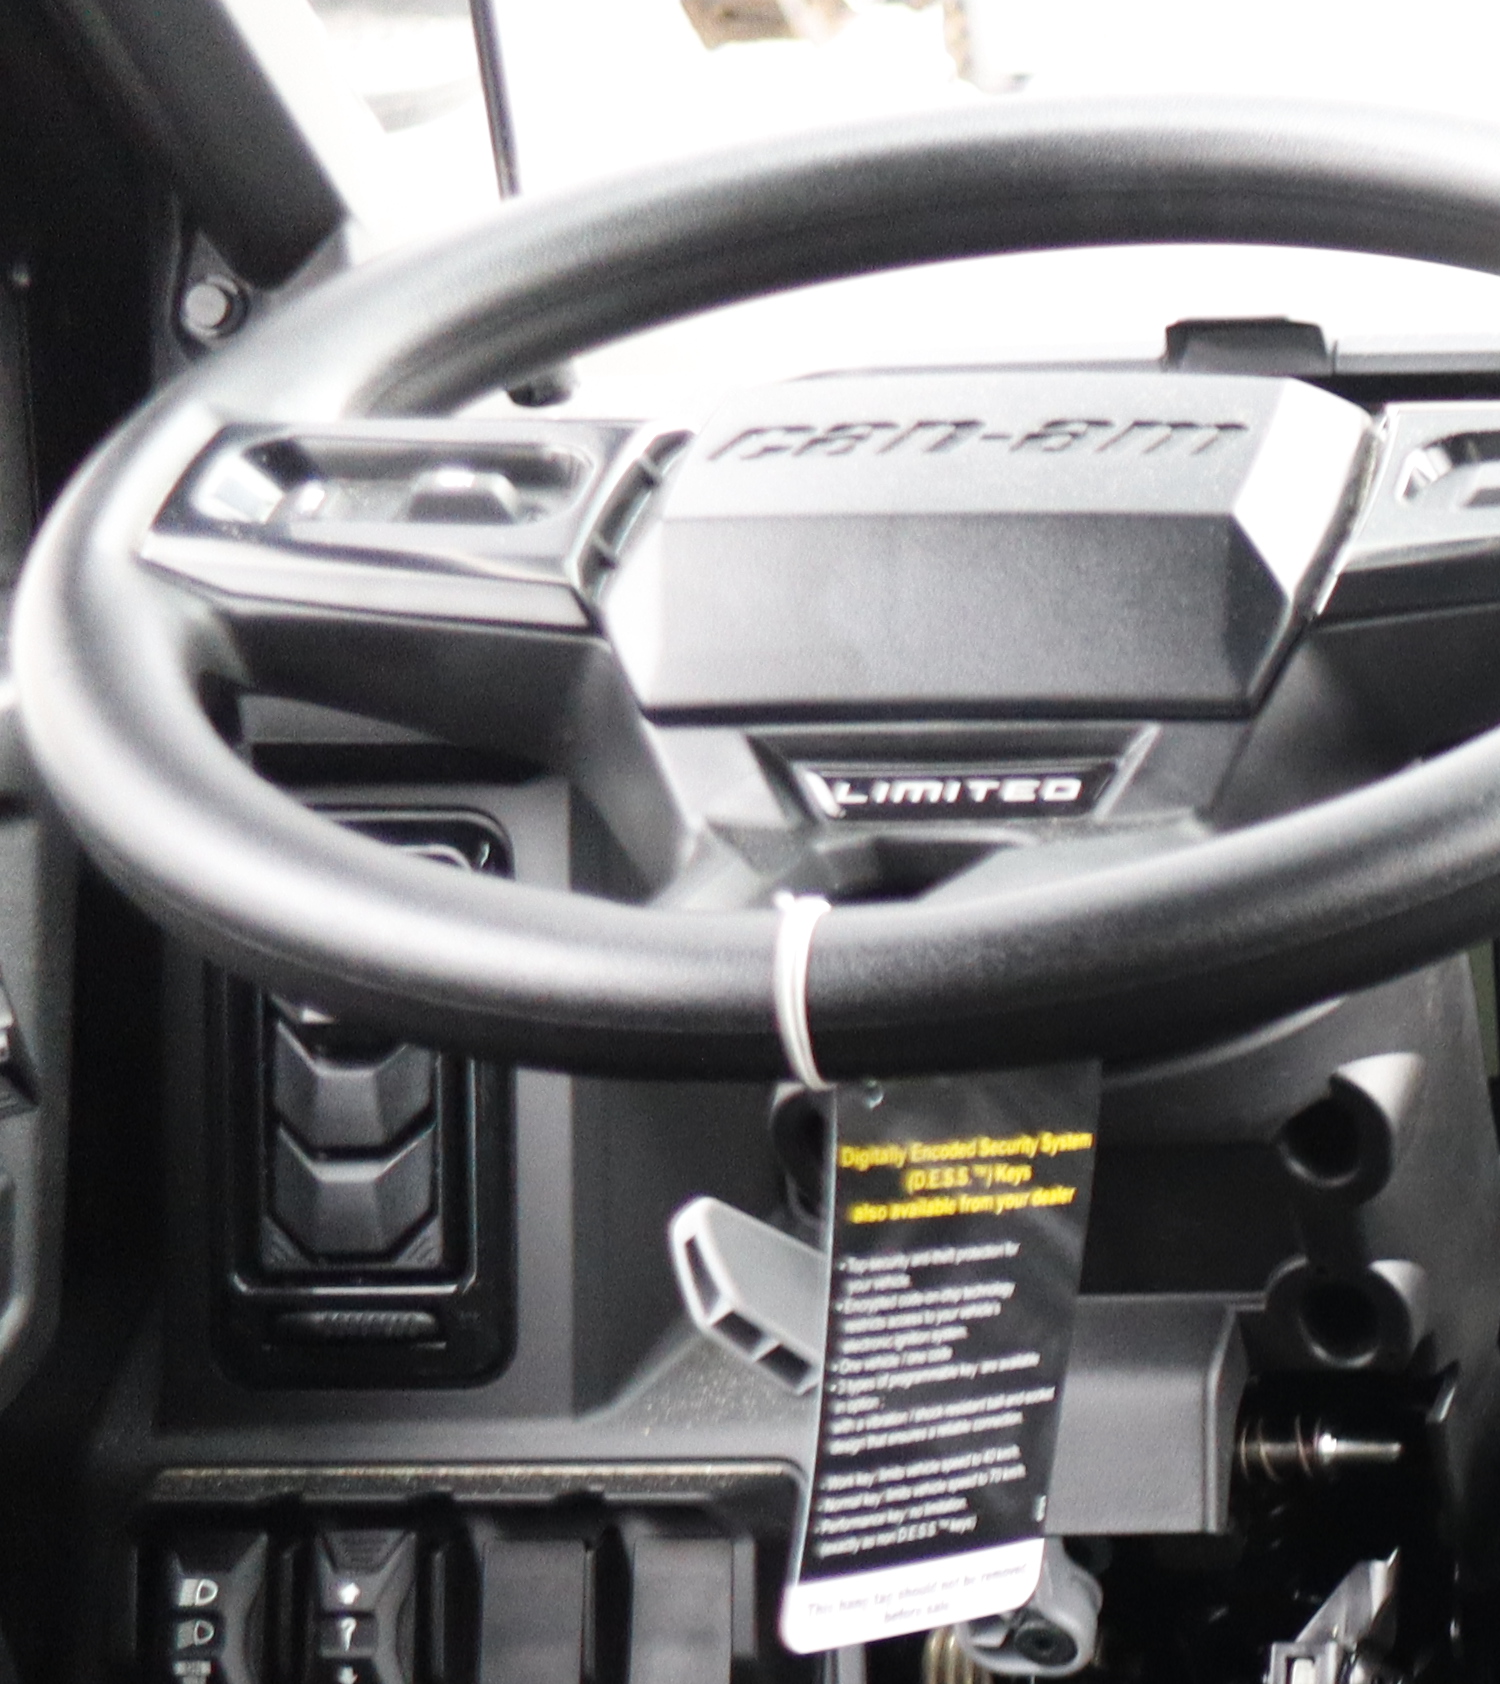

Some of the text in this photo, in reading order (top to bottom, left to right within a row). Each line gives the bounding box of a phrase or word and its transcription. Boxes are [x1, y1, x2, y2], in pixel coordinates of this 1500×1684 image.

[834, 778, 1083, 806] LIMITED
[839, 1131, 1093, 1172] Digitally Encoded Security System
[993, 1163, 1033, 1186] Keys
[851, 1186, 1076, 1223] also available from your dealer
